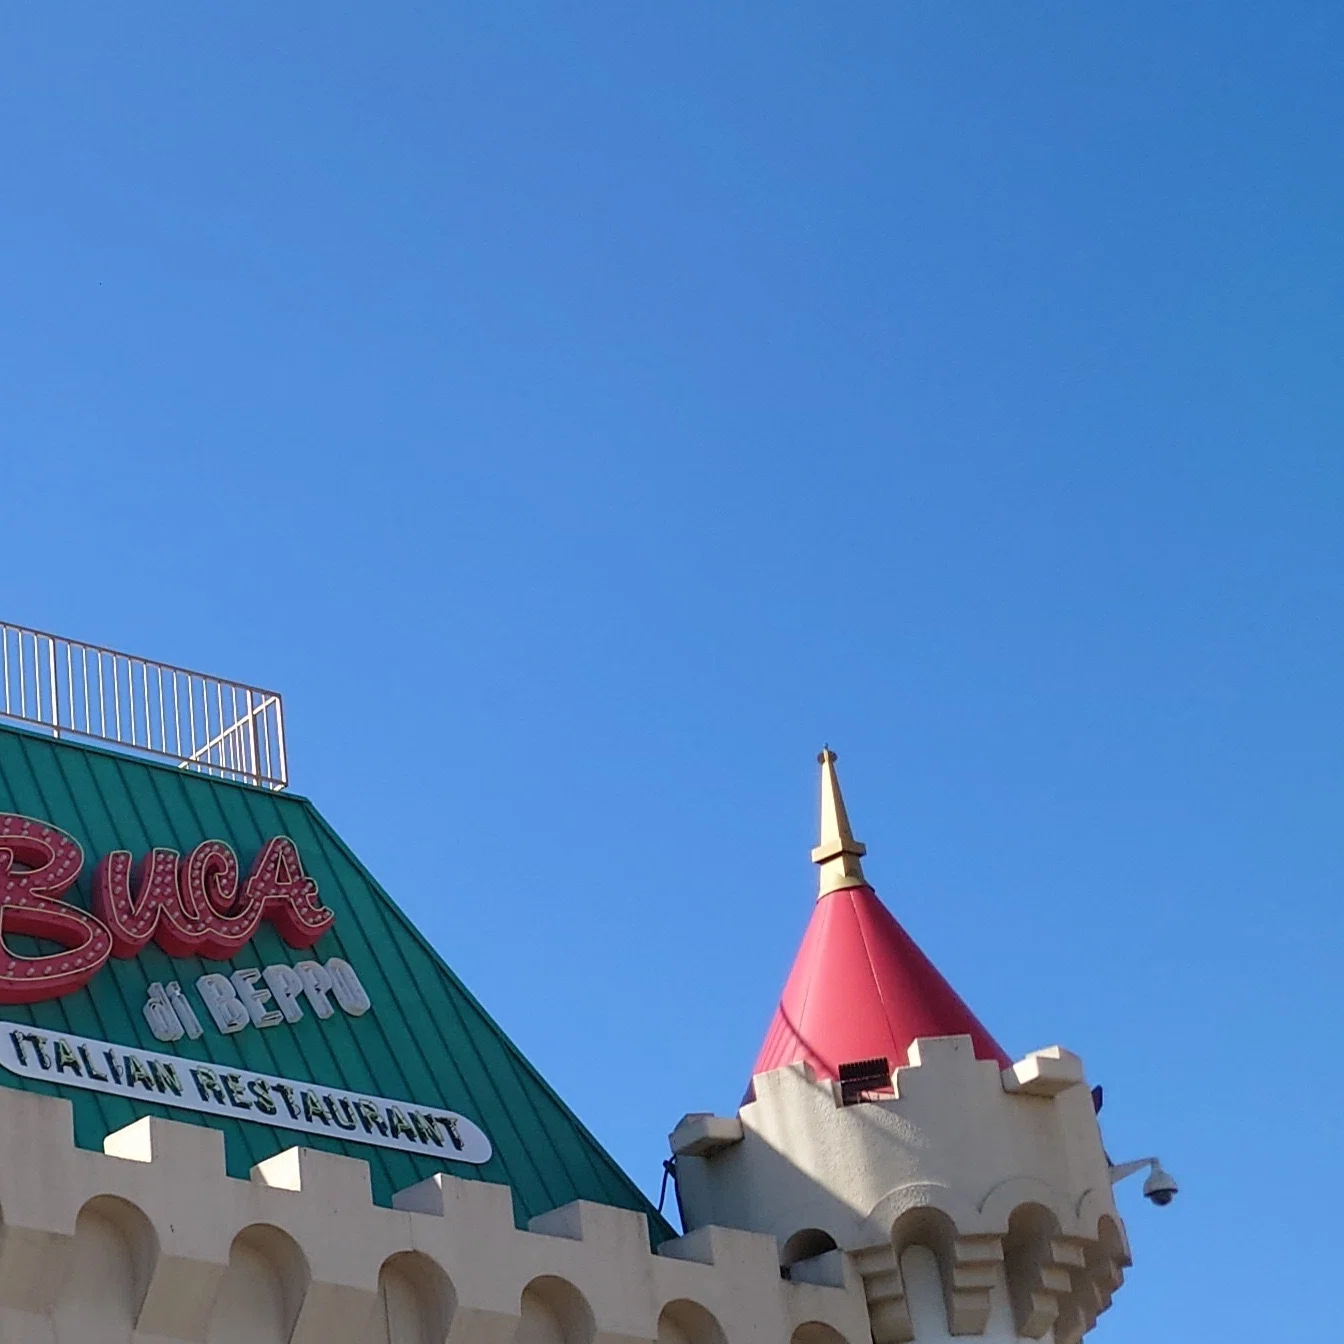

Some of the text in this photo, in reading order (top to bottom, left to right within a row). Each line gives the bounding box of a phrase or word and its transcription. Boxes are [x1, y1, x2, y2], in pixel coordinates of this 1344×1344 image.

[143, 957, 371, 1042] di BEPPO
[9, 1029, 466, 1152] ITALIAN RESTAURANT
